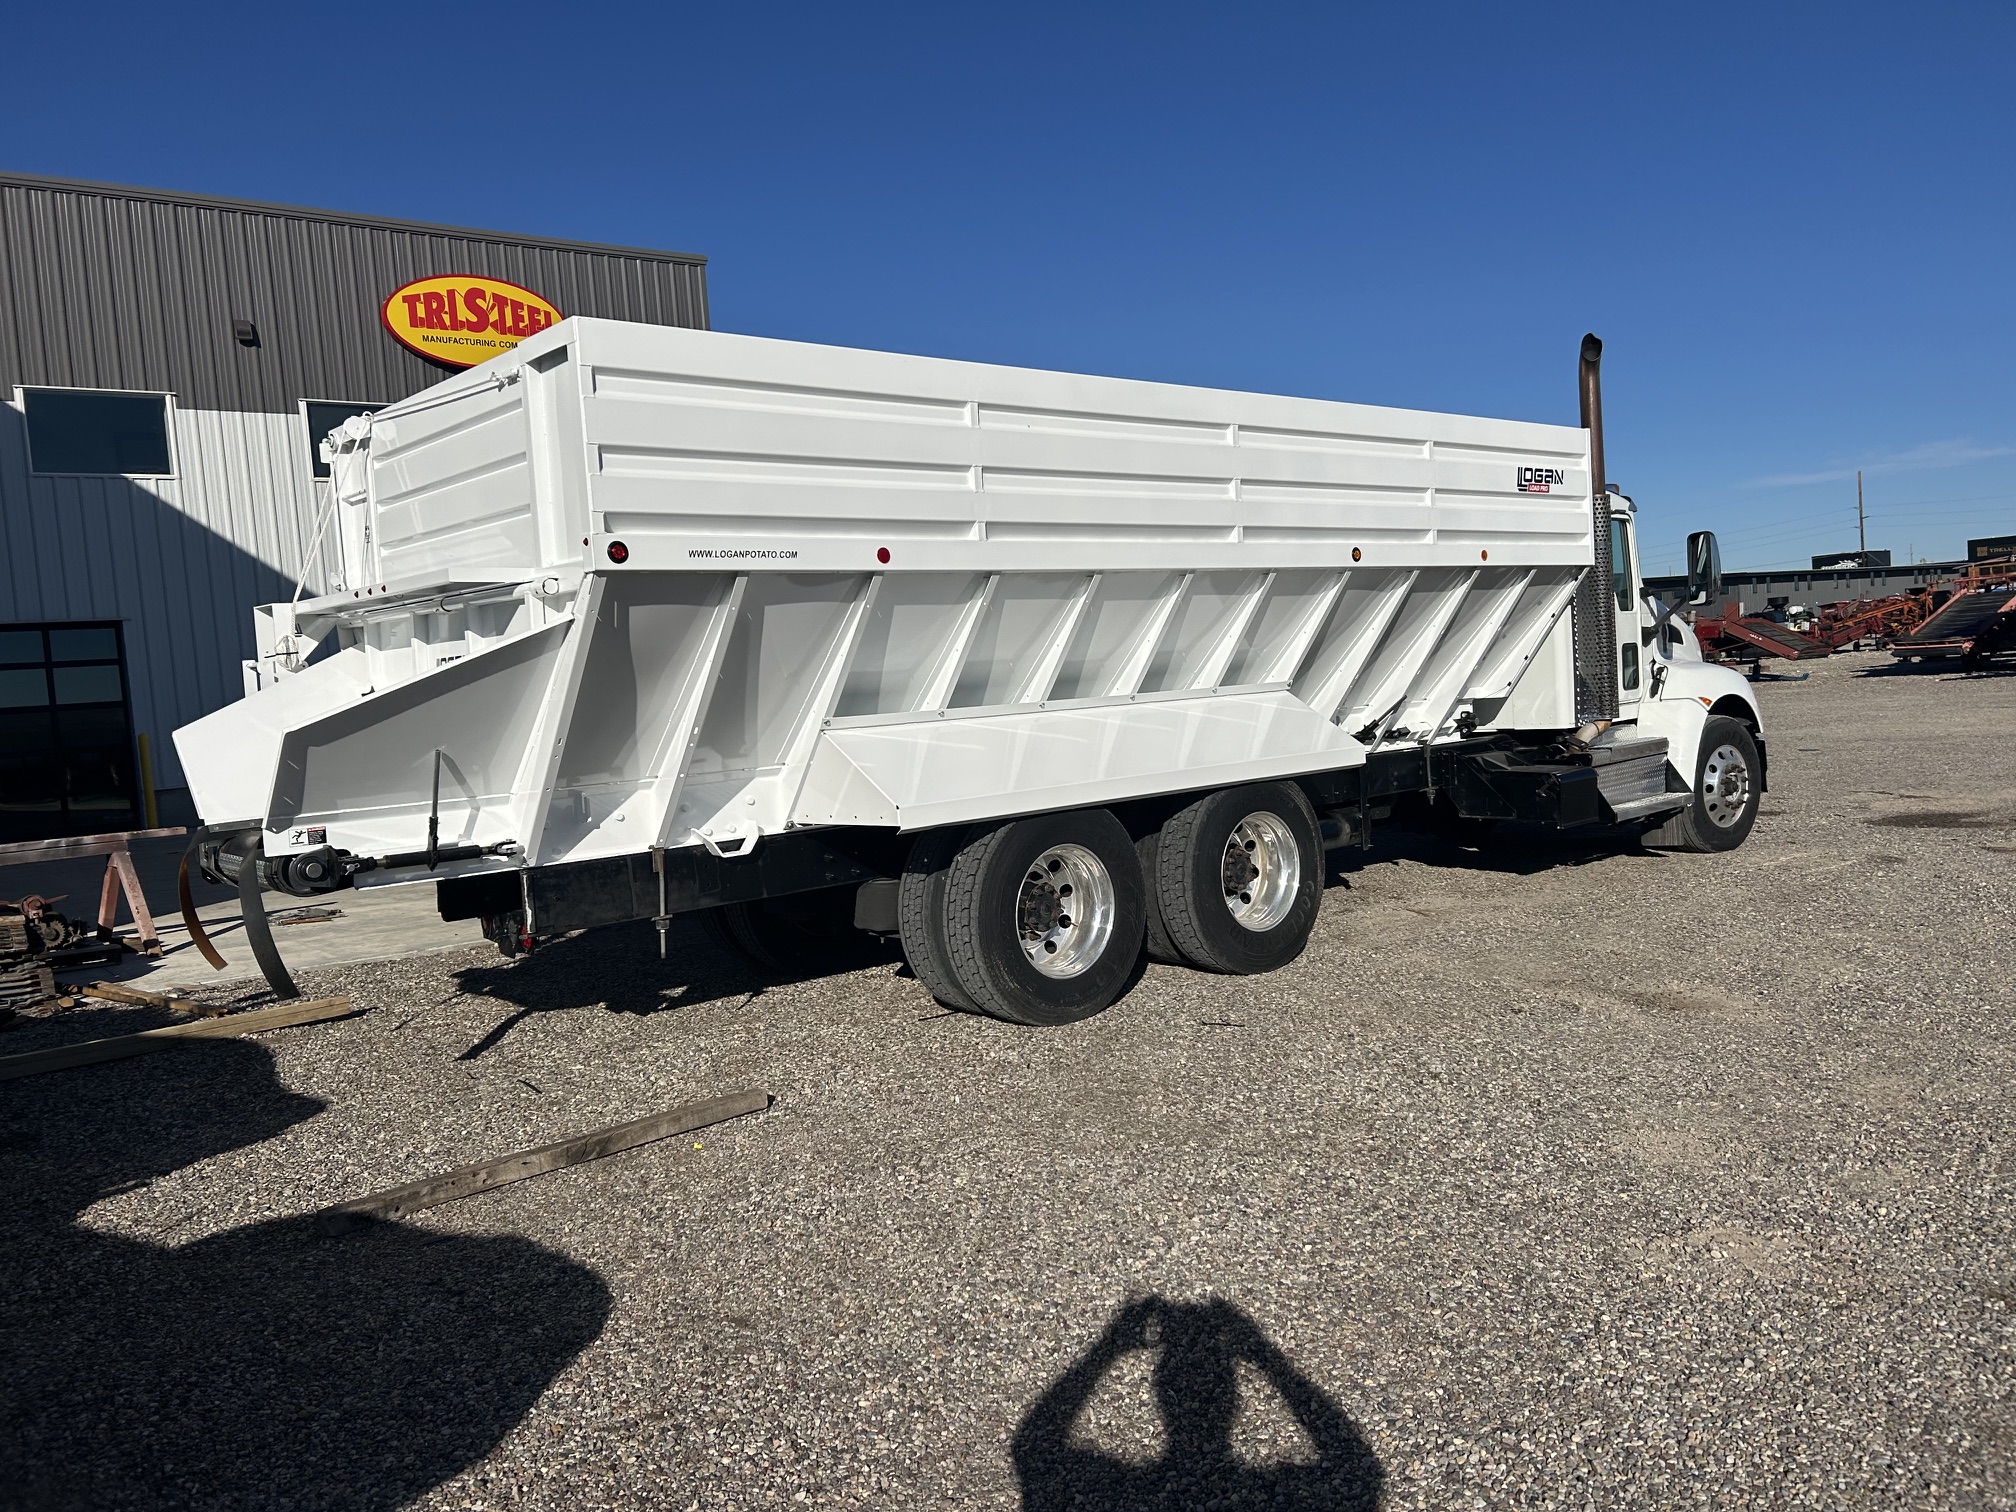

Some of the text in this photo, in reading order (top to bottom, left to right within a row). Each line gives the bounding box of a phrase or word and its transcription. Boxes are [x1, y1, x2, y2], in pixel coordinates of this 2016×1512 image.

[422, 334, 519, 349] MANUFACTURING COM
[688, 549, 798, 559] WWW.LOGANPOTATO.COM
